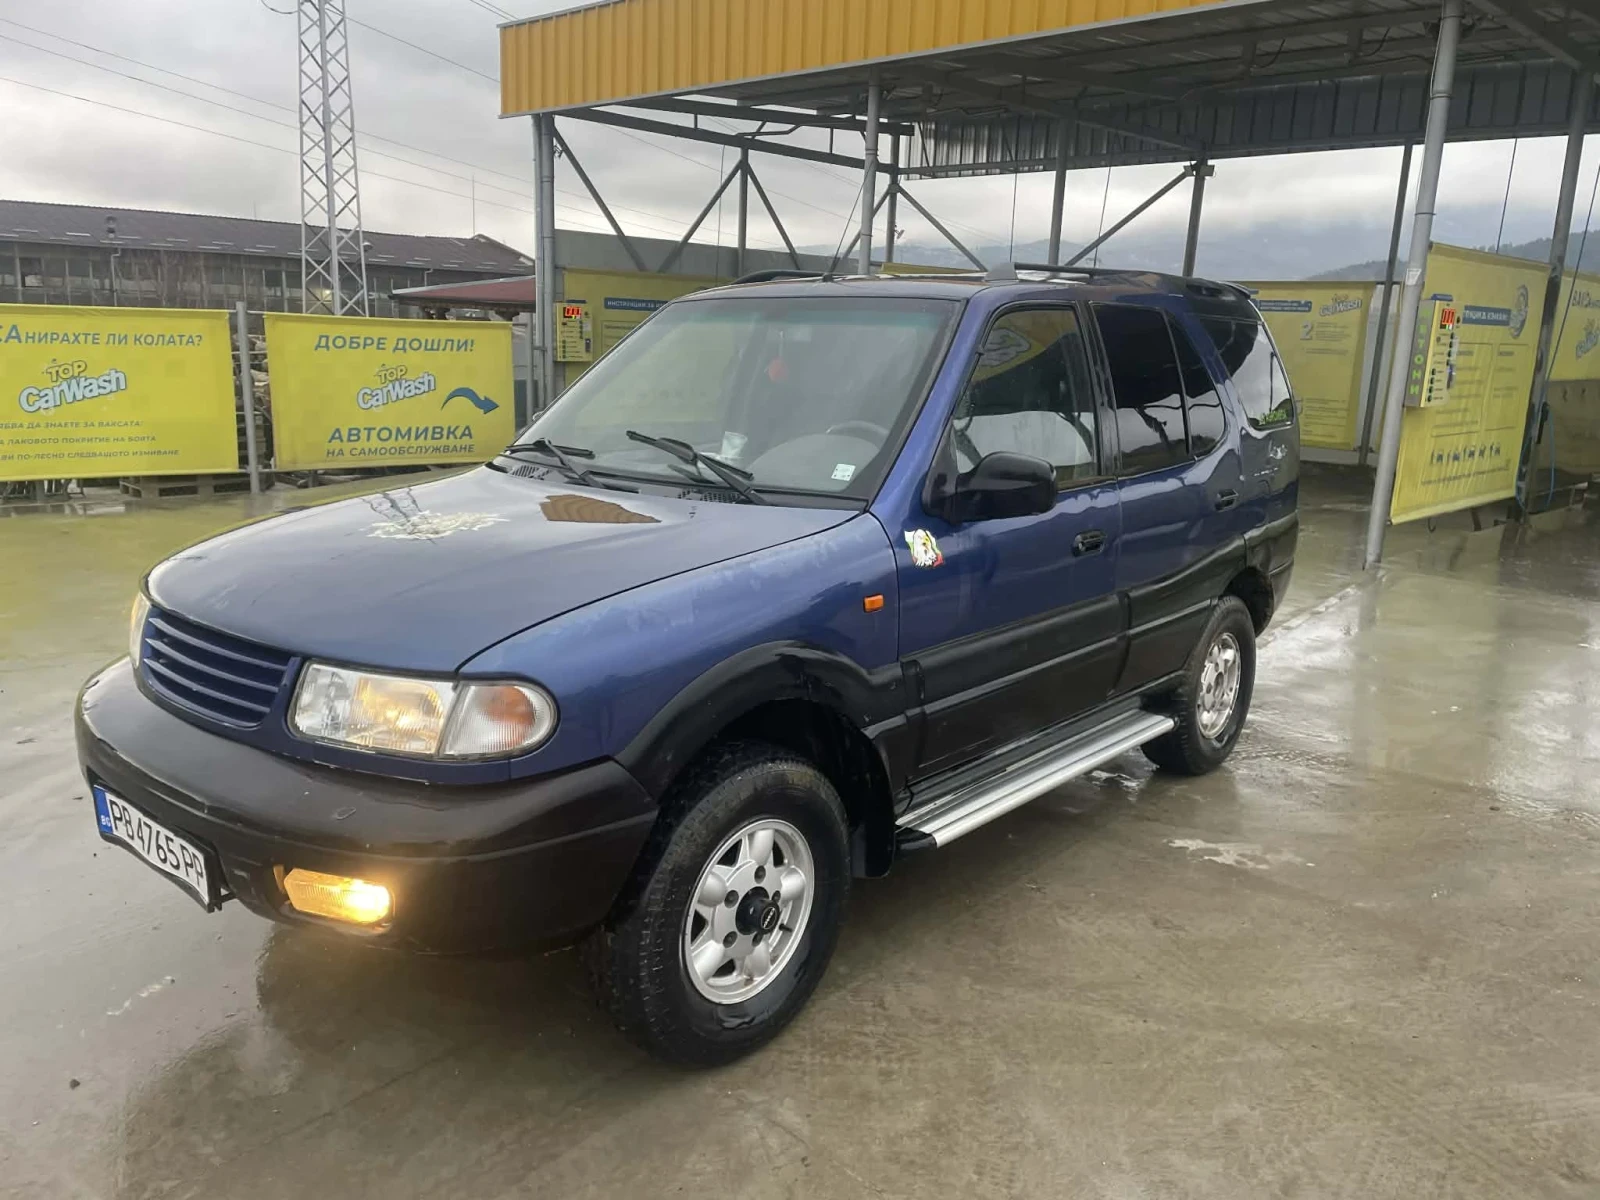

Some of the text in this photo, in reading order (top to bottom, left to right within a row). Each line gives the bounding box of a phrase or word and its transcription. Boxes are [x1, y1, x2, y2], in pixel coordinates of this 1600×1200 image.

[0, 324, 203, 346] АНИРАХТЕ ЛИ КОЛАТА?
[314, 335, 475, 354] ДОБРЕ ДОШЛИ!
[46, 360, 87, 383] TOP
[377, 364, 407, 384] TOP
[19, 368, 127, 413] CarWash
[357, 371, 436, 410] CarWash
[26, 422, 41, 430] ДА
[44, 421, 80, 429] ЗНАЕТЕ
[328, 425, 473, 443] АВТОМИВКА
[326, 443, 475, 458] НА САМООБСЛУЖВАНЕ
